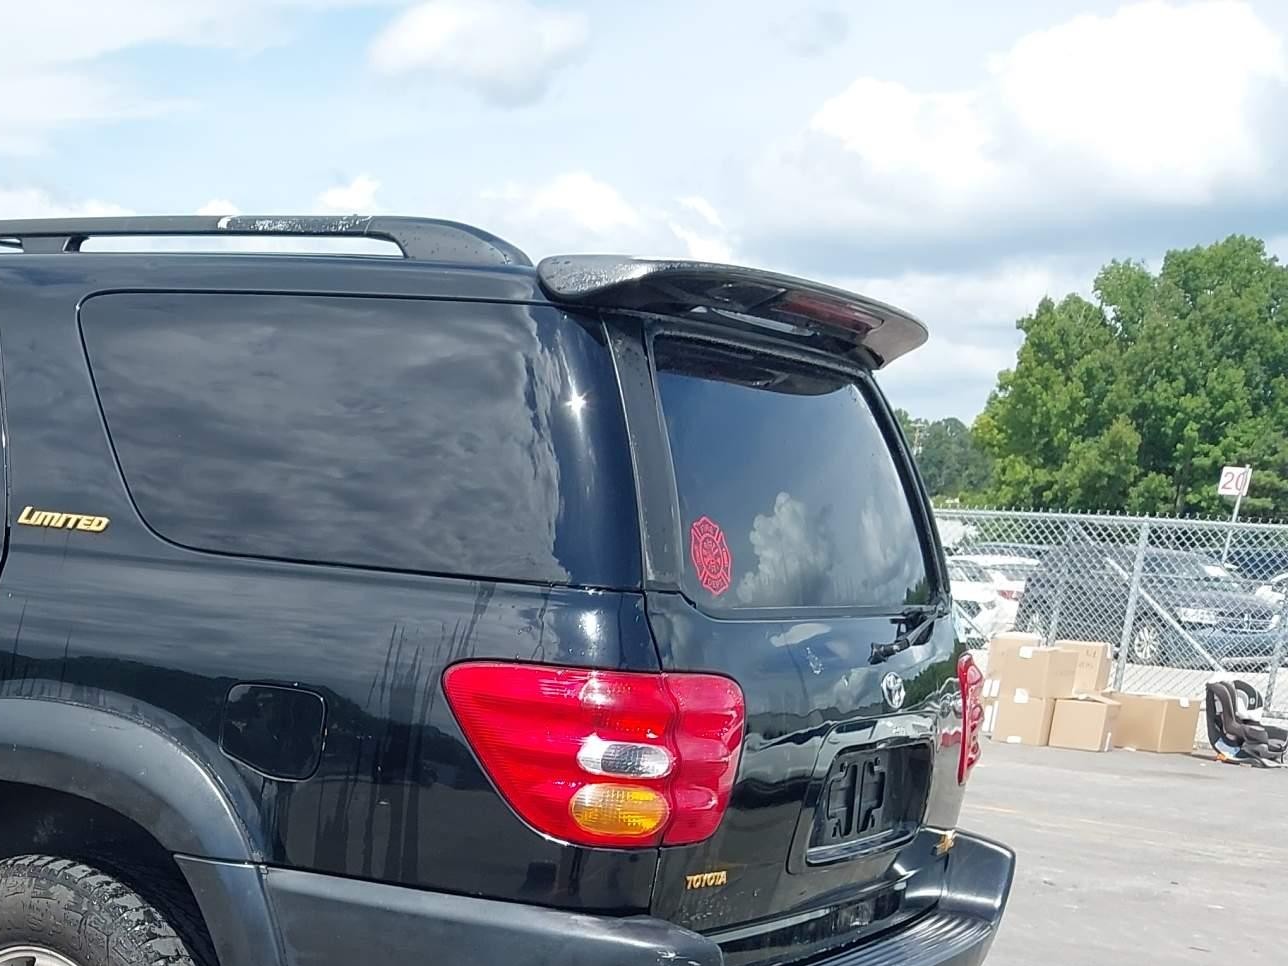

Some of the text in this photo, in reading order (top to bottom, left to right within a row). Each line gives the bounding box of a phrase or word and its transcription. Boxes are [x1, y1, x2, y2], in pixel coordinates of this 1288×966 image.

[1221, 471, 1249, 491] 20
[17, 506, 111, 533] LIMITED
[686, 870, 728, 890] TOYOTA
